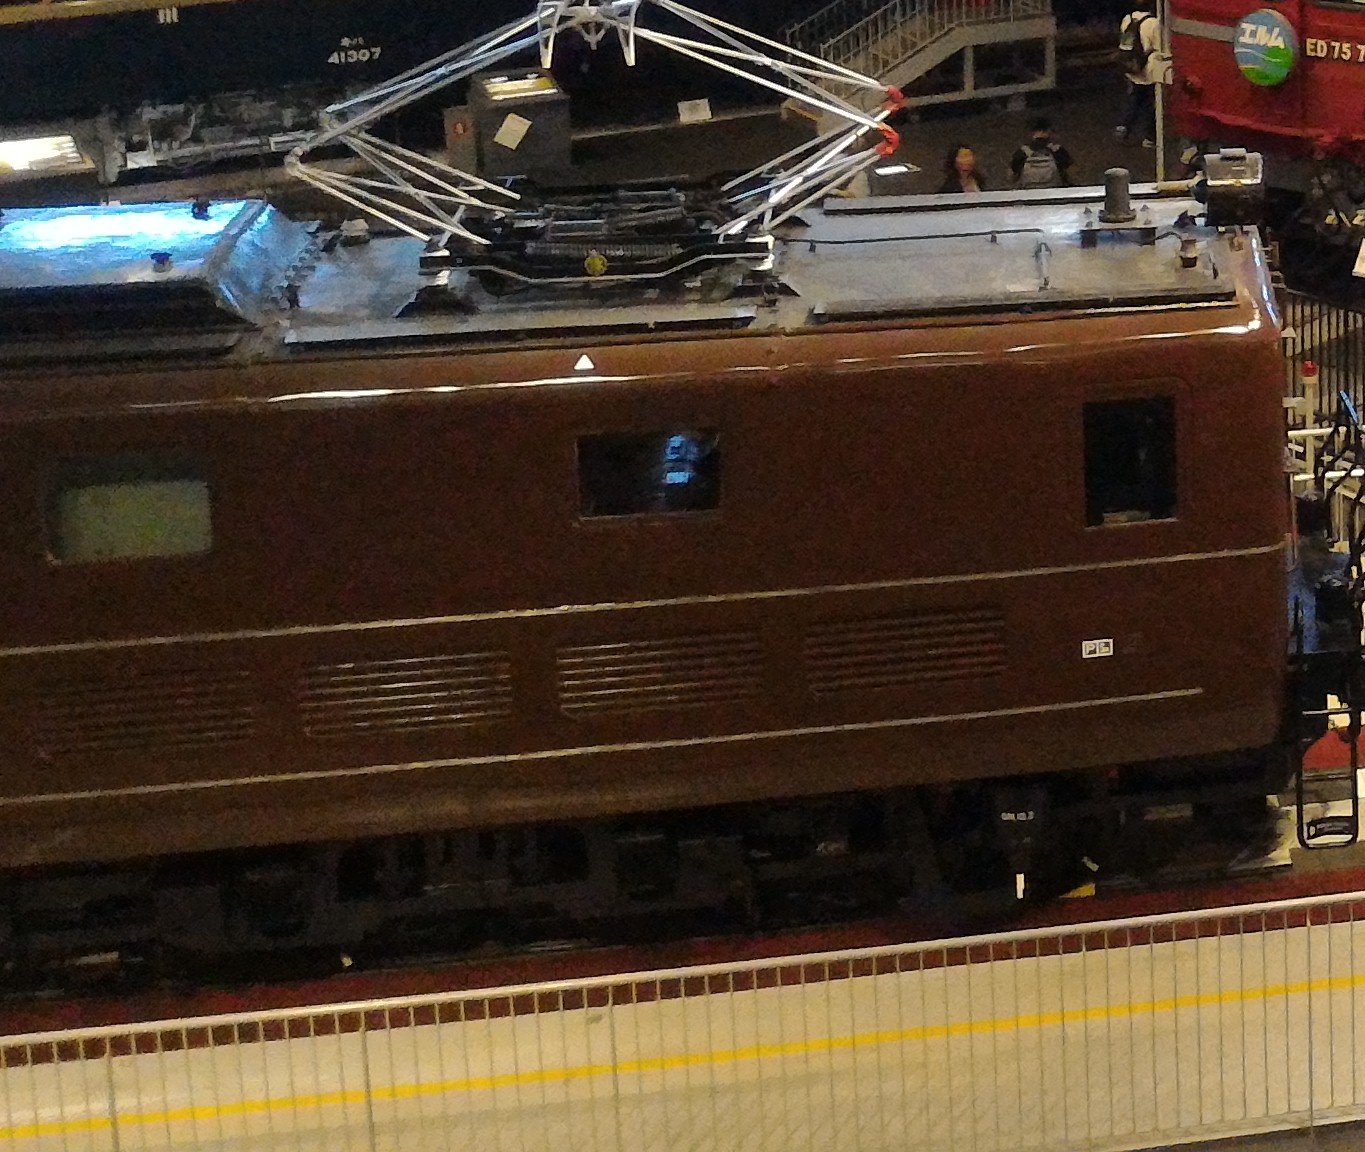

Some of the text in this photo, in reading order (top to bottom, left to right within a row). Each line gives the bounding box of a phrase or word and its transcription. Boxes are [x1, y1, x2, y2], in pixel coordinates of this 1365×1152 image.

[1238, 22, 1285, 49] エルム
[327, 46, 382, 65] 41307
[1306, 37, 1328, 58] ED
[1330, 41, 1352, 61] 75
